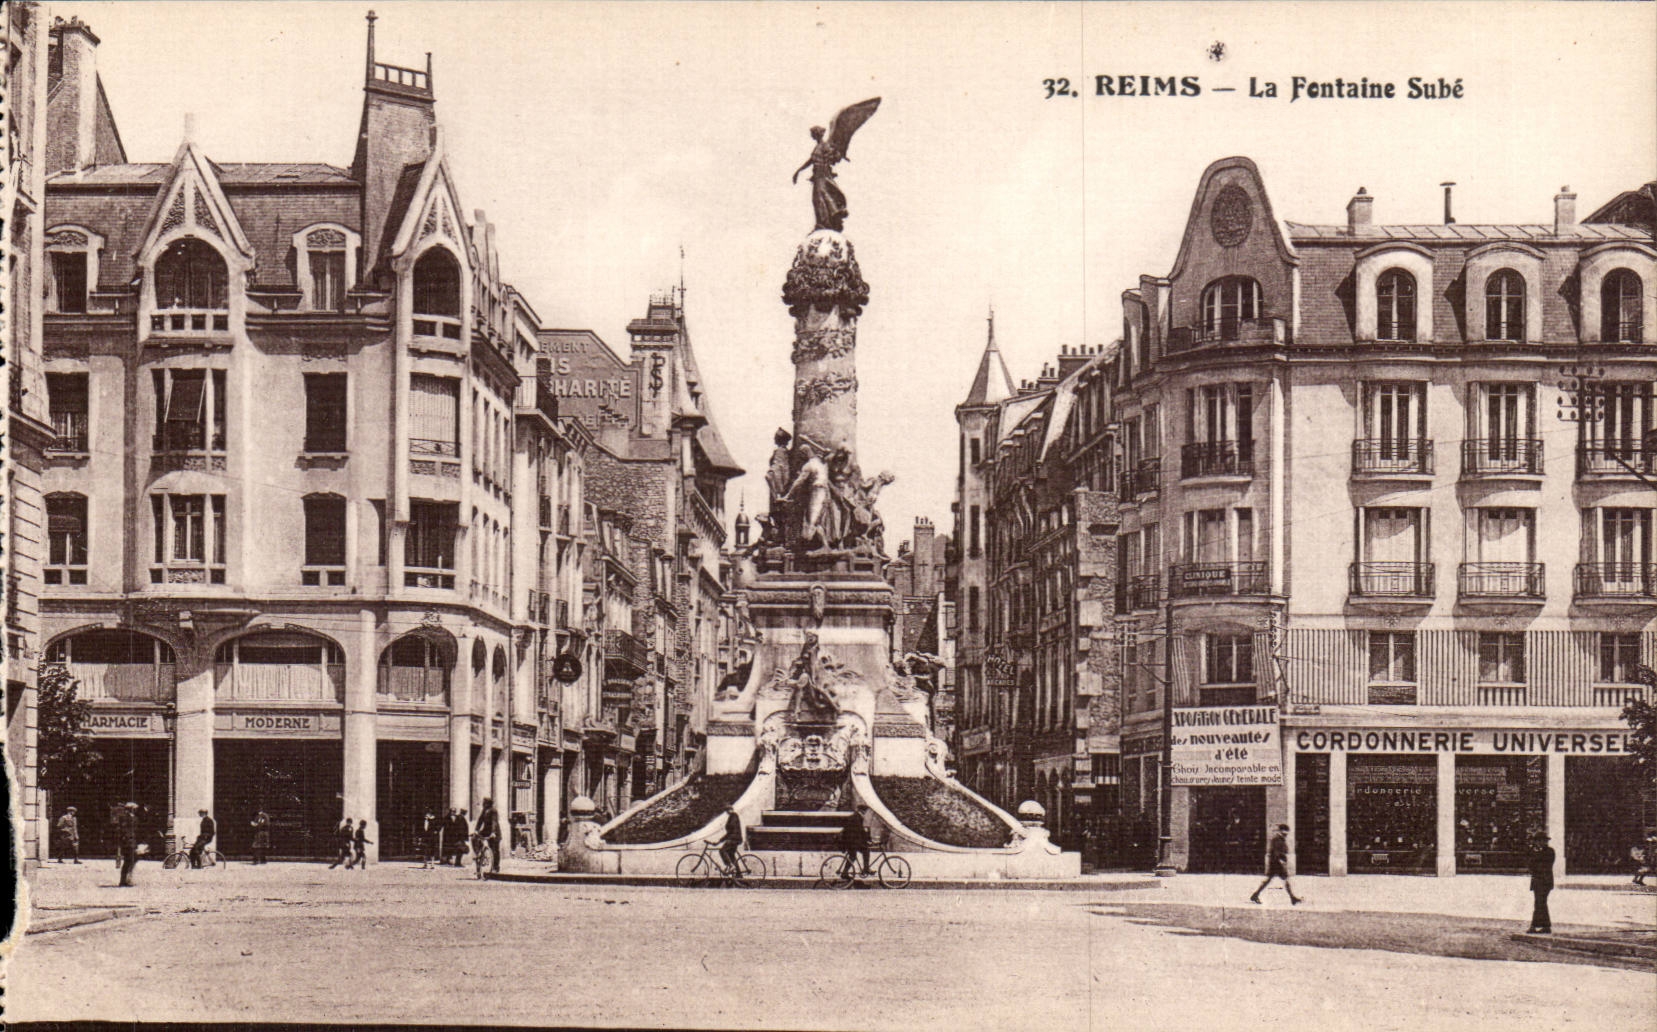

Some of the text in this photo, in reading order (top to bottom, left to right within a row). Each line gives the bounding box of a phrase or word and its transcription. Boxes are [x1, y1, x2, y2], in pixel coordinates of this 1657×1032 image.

[83, 716, 311, 730] HARMACIE MODERNE
[1190, 731, 1270, 744] nouveautés
[1296, 731, 1635, 752] CORDONNERIE UNIVERSEL
[1214, 747, 1249, 760] d'été
